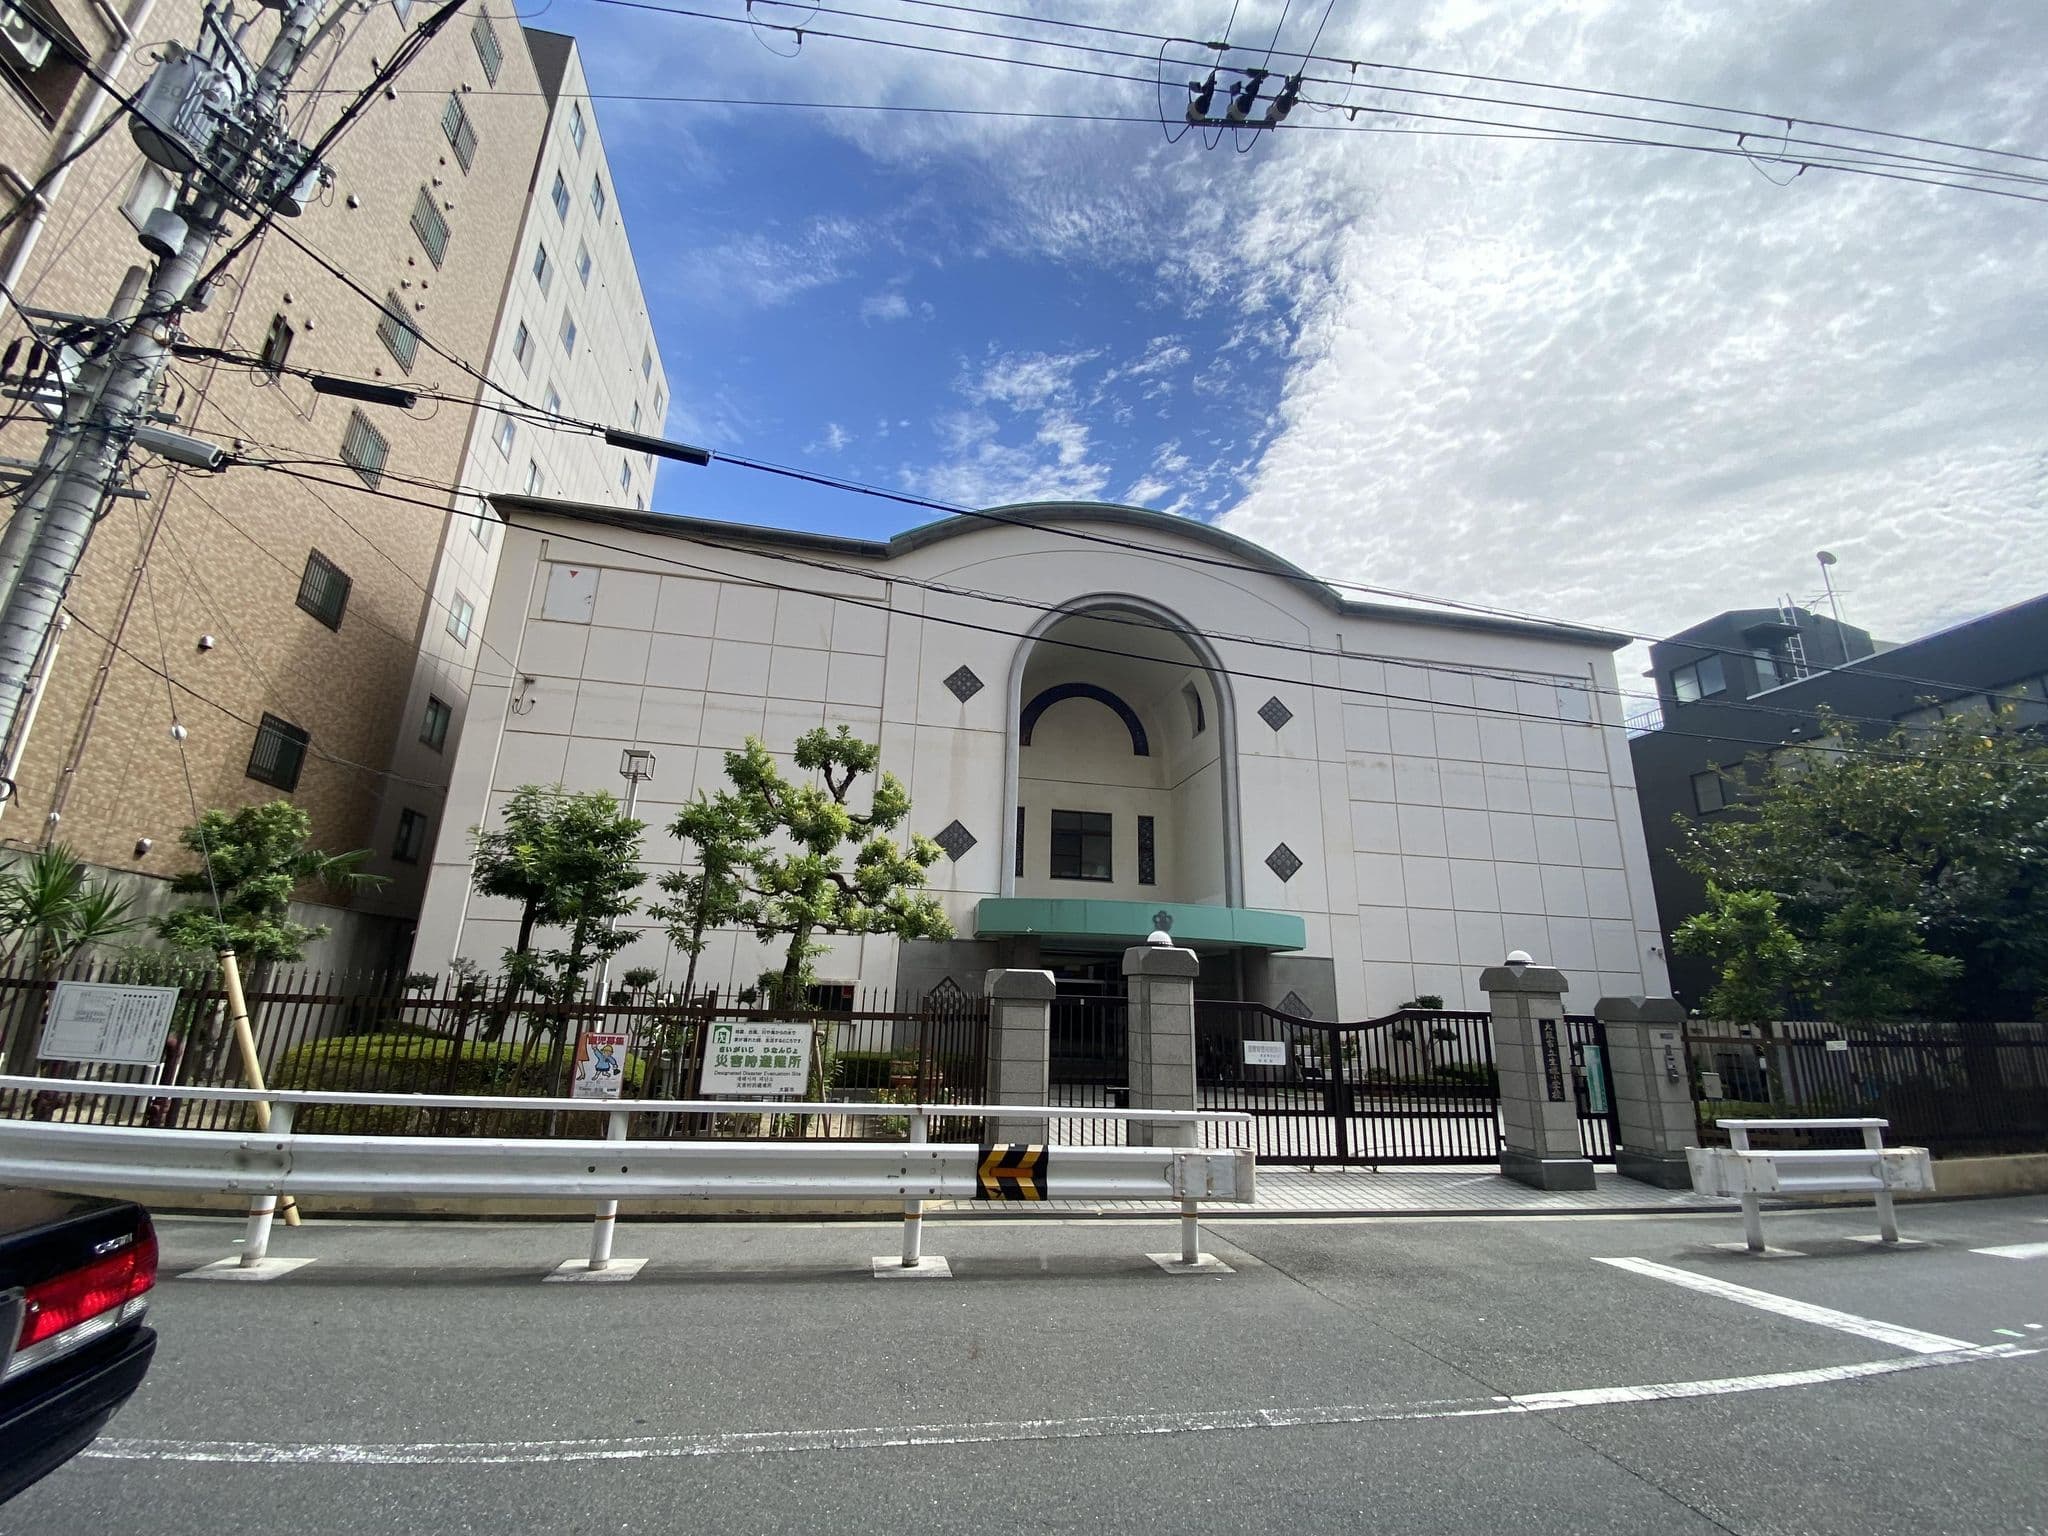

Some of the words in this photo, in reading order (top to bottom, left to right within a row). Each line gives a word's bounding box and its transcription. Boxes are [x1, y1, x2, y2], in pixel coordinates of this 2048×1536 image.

[588, 1036, 625, 1045] 園児募集
[714, 1054, 802, 1069] 災害時避難所
